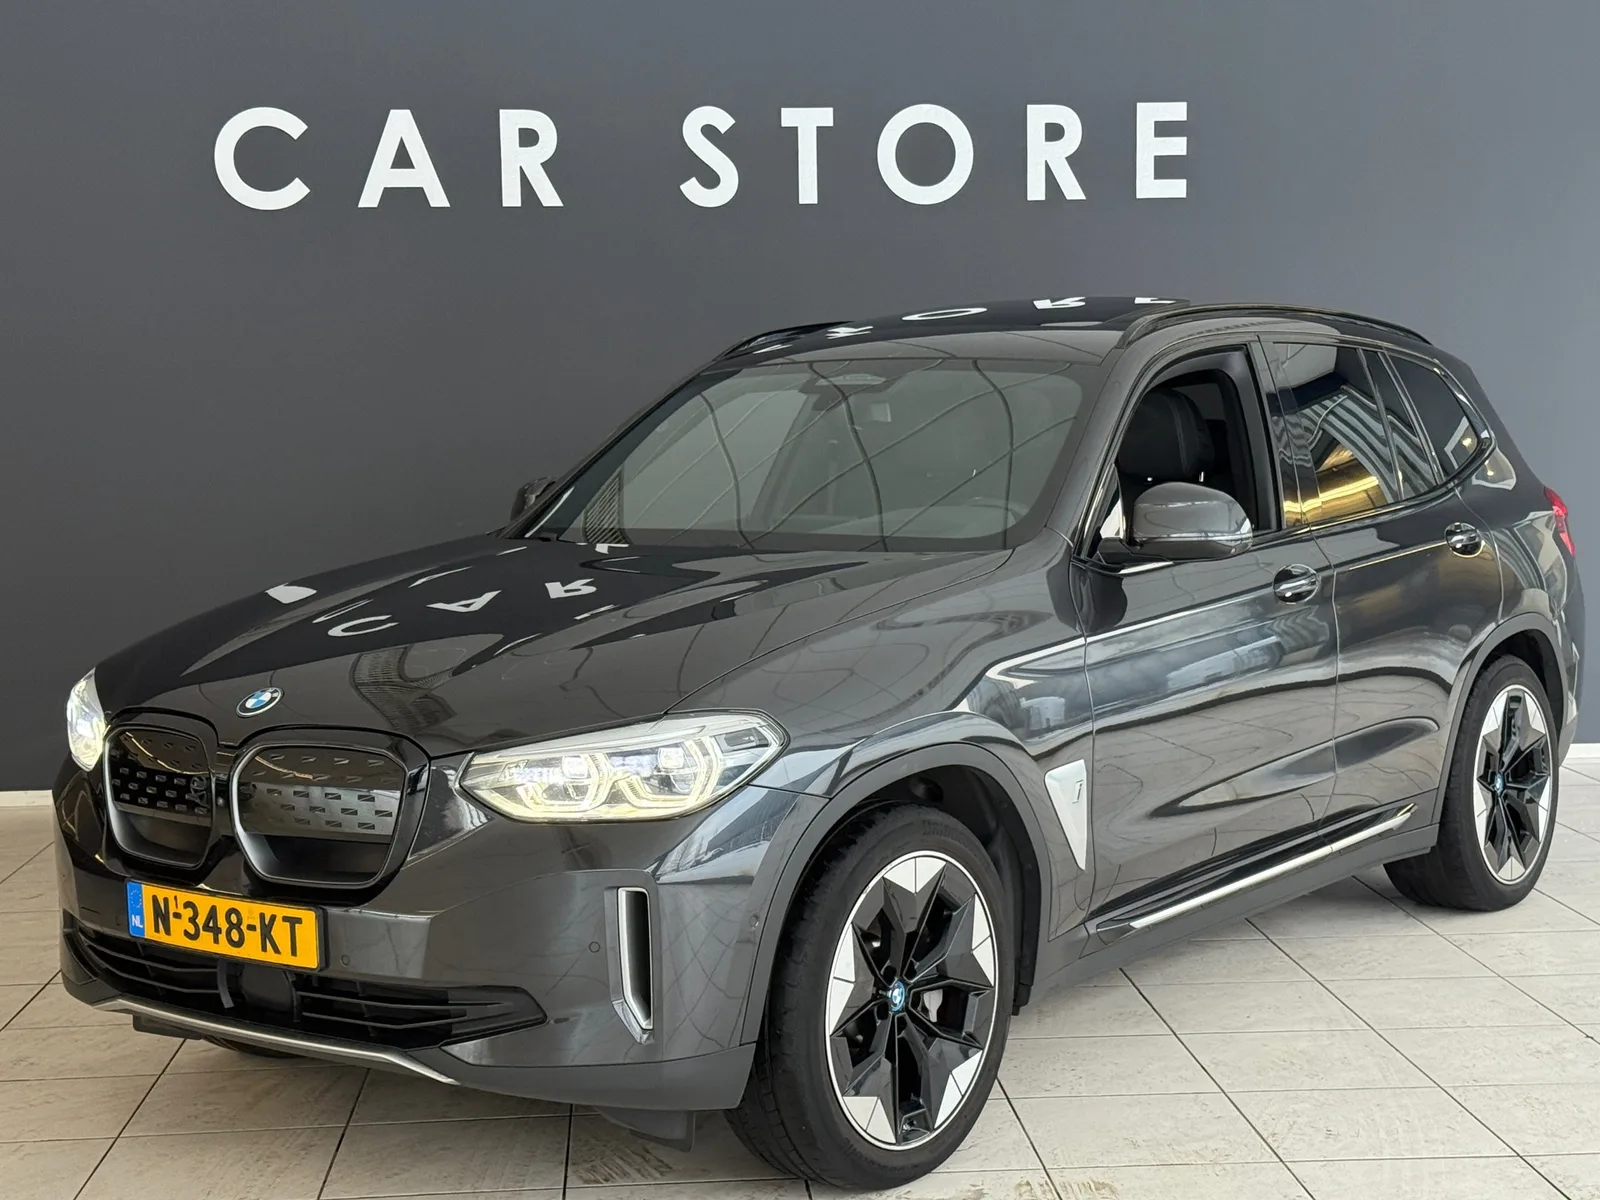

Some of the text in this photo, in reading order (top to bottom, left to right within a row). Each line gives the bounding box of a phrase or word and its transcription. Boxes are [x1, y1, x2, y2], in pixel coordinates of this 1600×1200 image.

[214, 102, 1188, 210] CAR STORE
[131, 915, 143, 928] NL
[152, 895, 303, 957] N-348-KT
